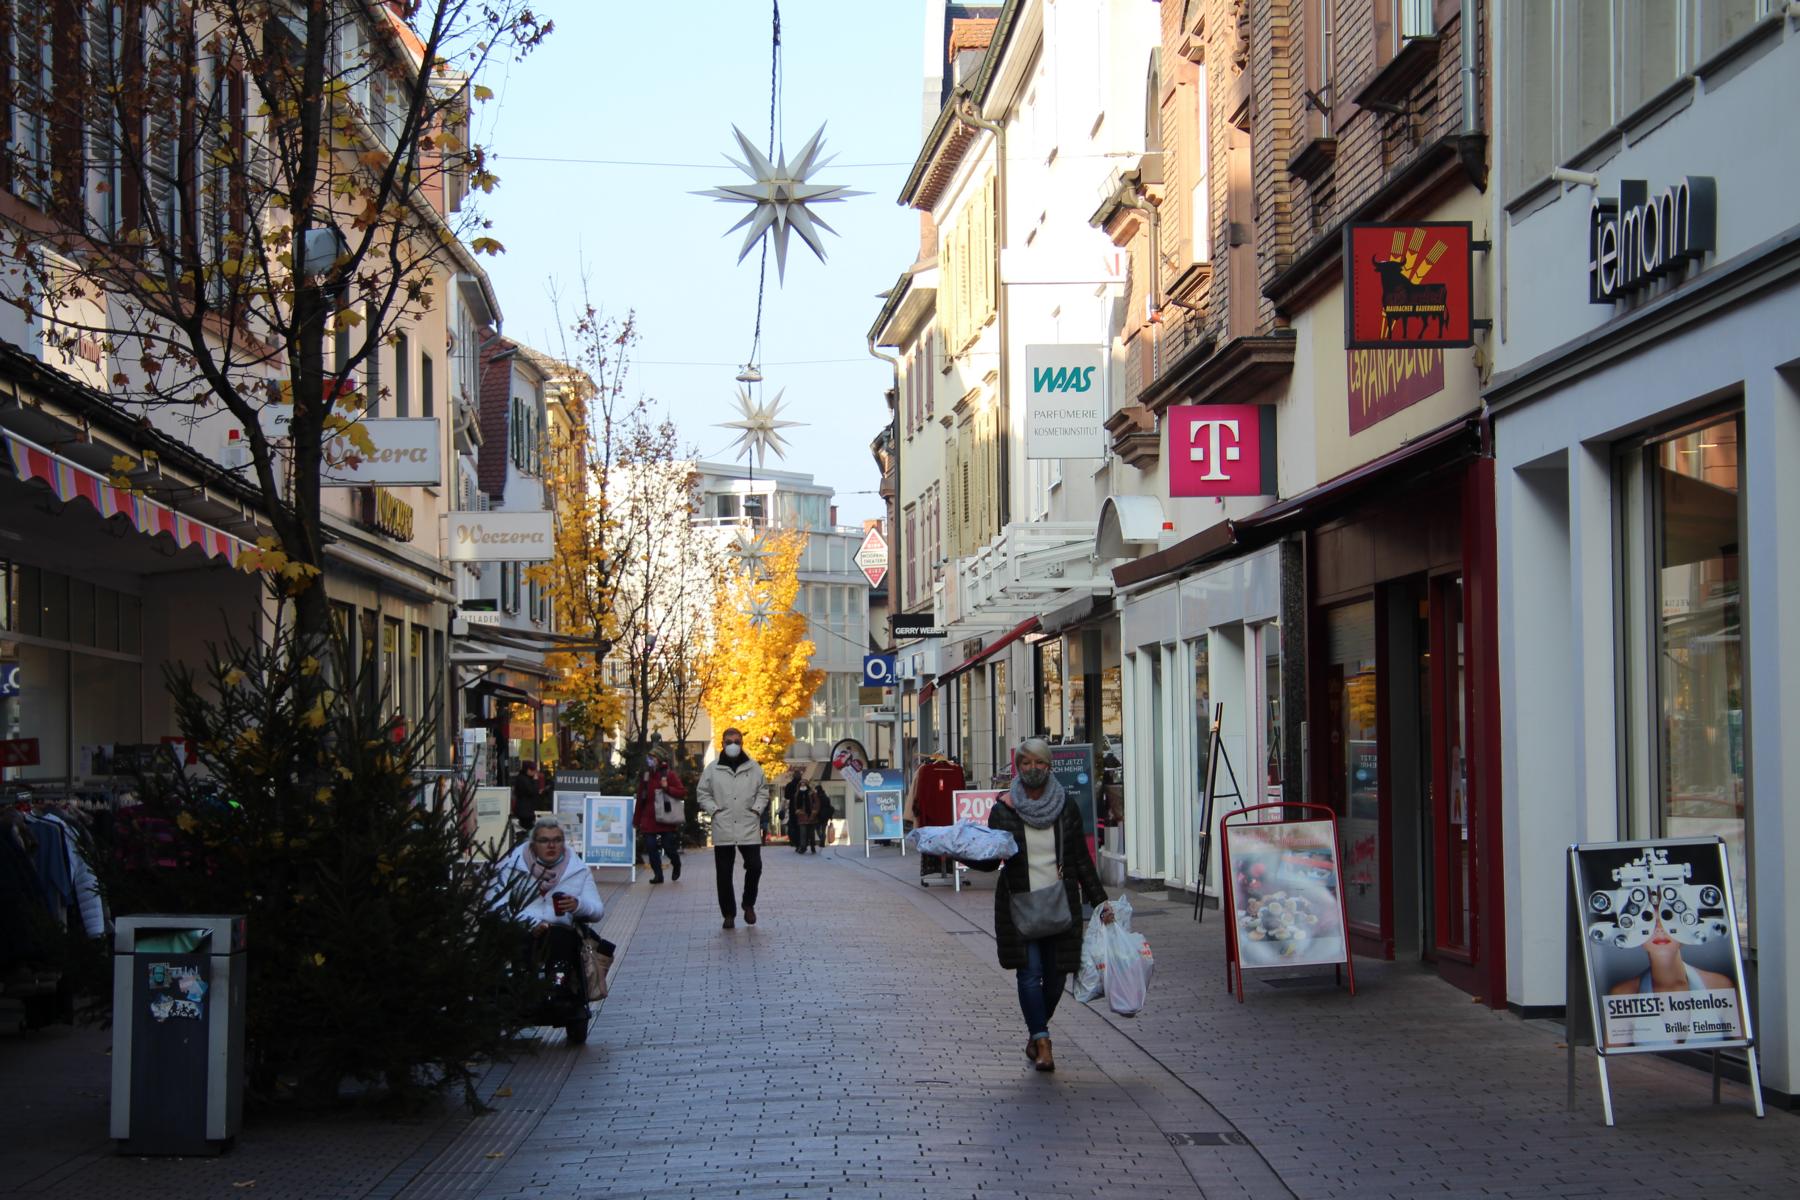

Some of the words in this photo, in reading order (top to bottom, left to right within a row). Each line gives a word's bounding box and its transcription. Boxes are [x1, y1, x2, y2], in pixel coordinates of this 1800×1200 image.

[1588, 176, 1690, 300] fielmann
[1033, 365, 1096, 393] WAAS
[1034, 408, 1098, 419] PARFÜMERIE
[1034, 427, 1098, 436] KOSMETIKINSTITUT
[1190, 420, 1240, 480] T
[457, 524, 545, 544] Weczera
[895, 627, 919, 635] GERRY
[866, 658, 892, 683] O2
[557, 776, 599, 784] WELTLADEN
[1608, 998, 1665, 1016] SEHTEST:
[1669, 993, 1733, 1012] kostenlos.
[1664, 1022, 1691, 1033] Brille:
[1693, 1020, 1736, 1033] Fielmann.
